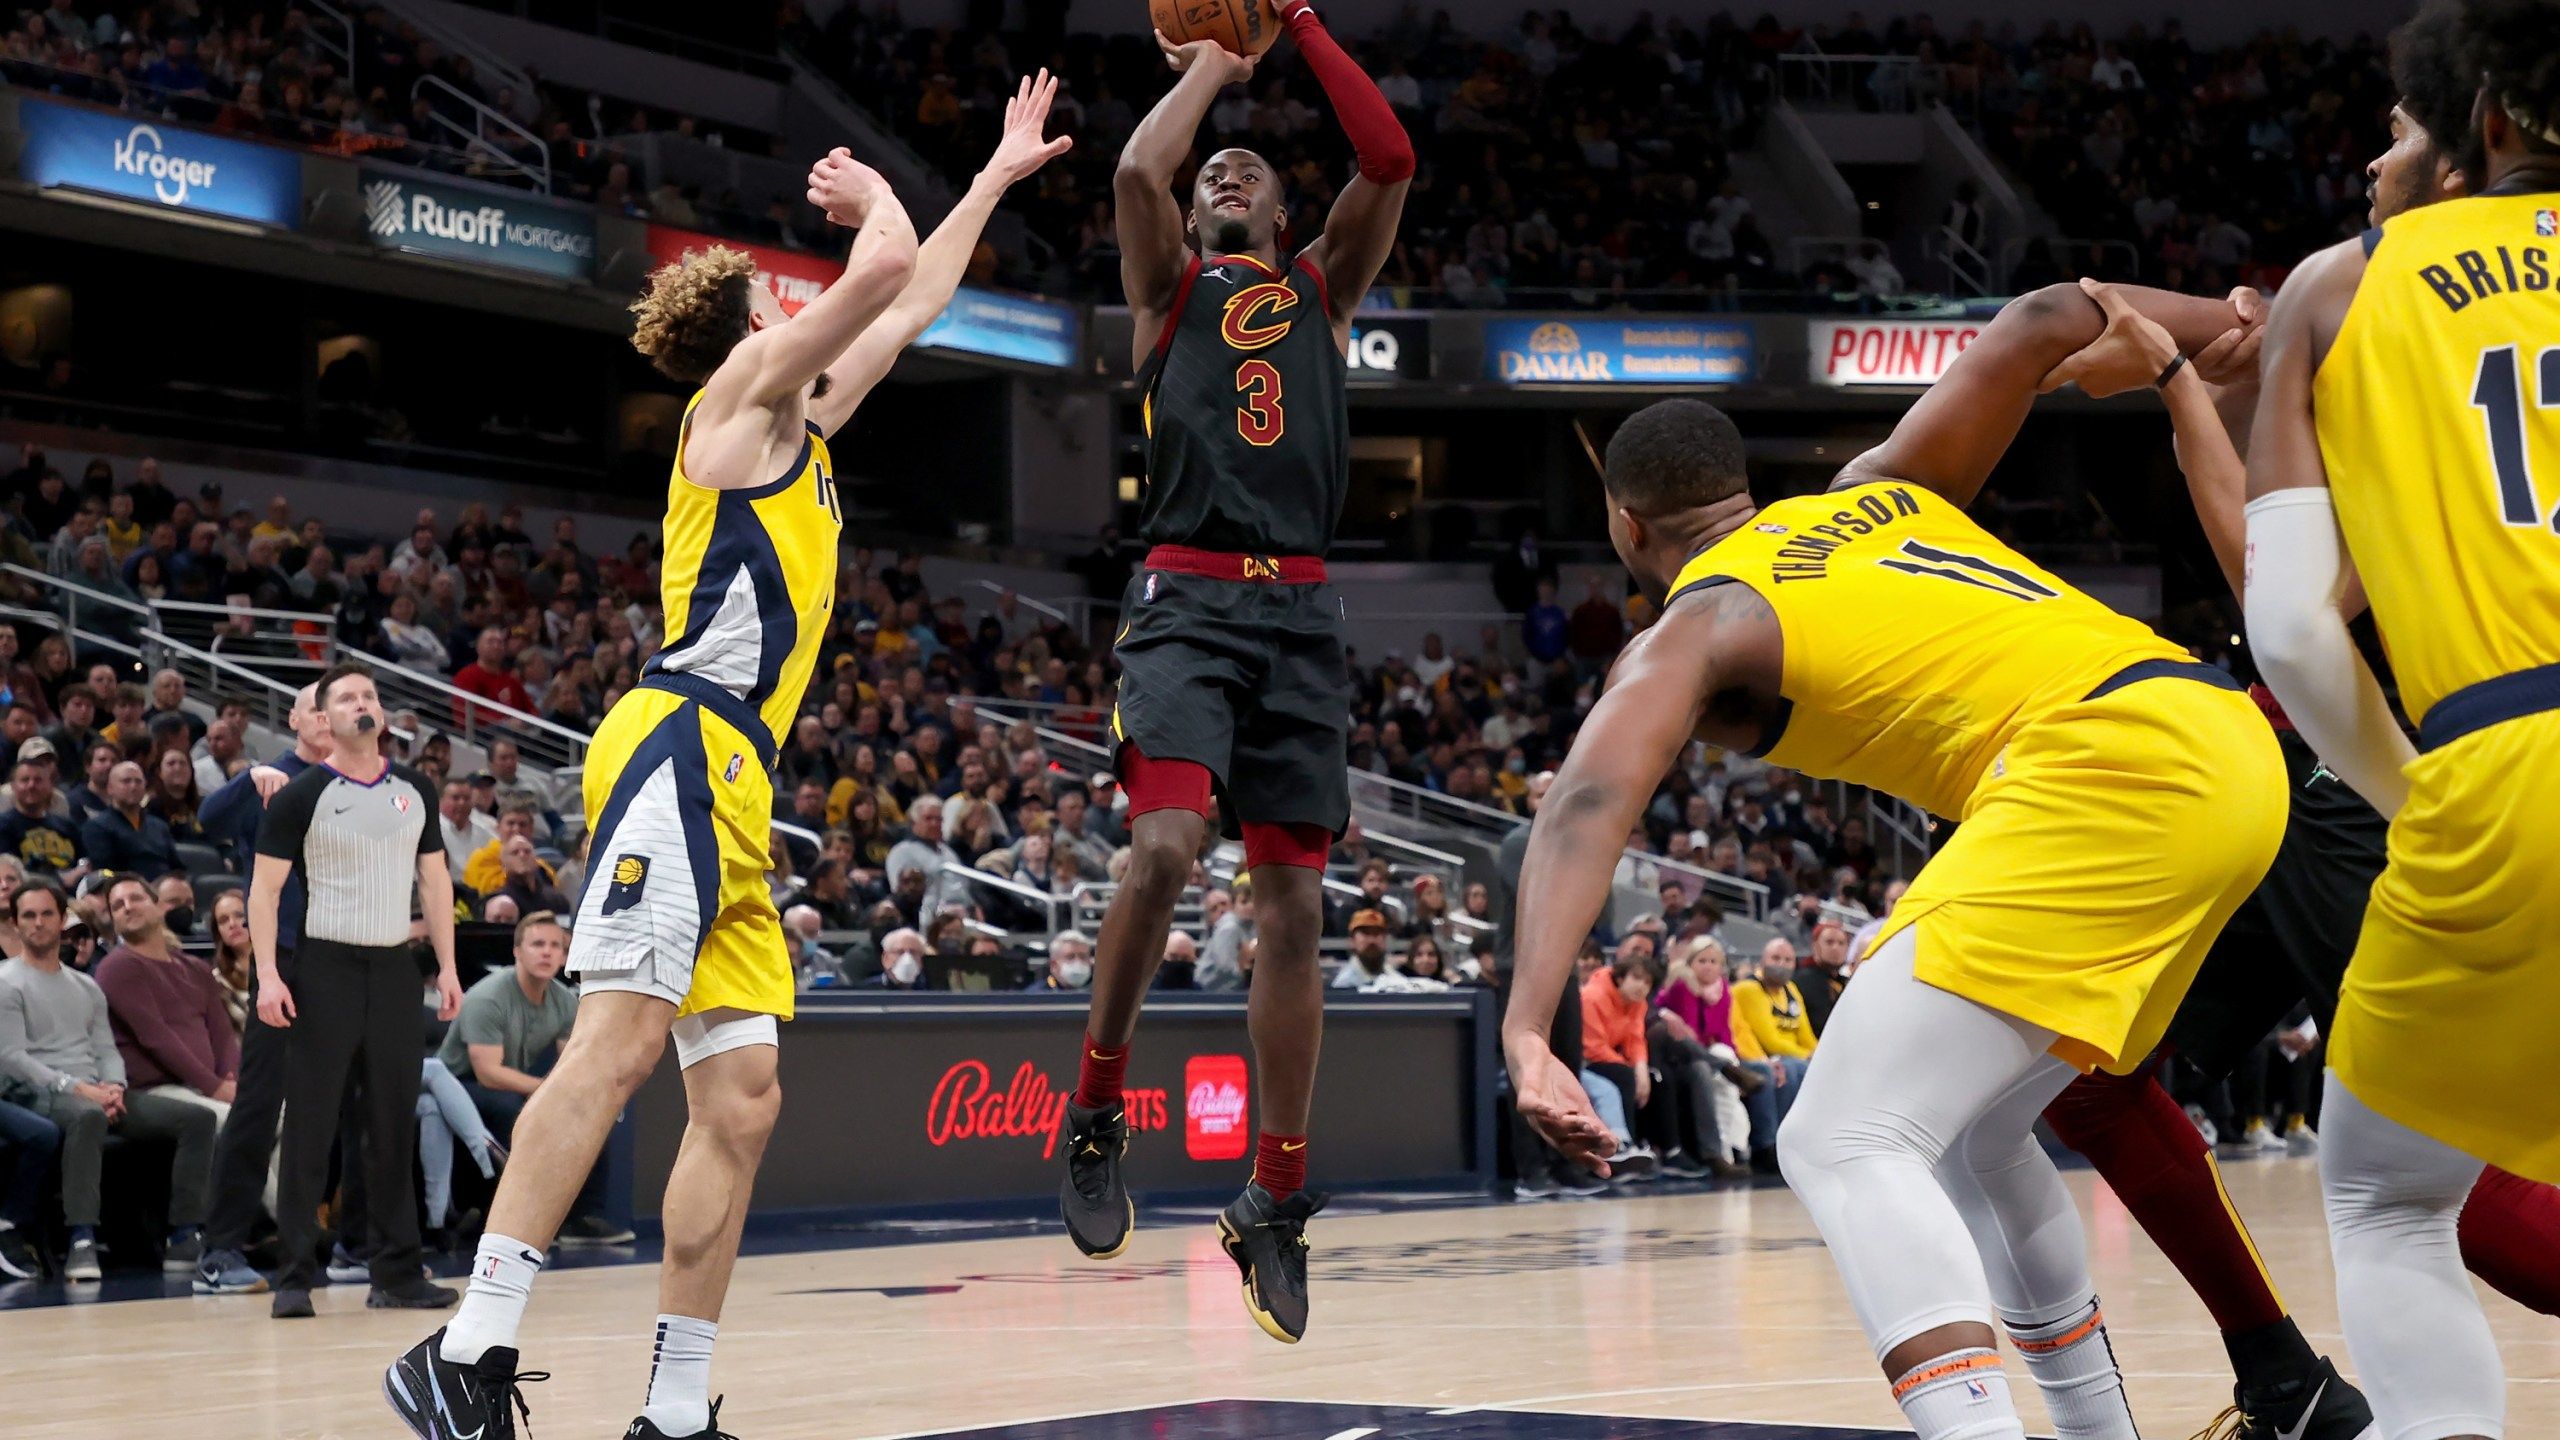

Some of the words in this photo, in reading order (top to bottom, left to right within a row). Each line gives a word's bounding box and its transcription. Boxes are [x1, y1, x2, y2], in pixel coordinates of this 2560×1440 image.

[114, 124, 216, 206] Kroger
[412, 194, 505, 248] Ruoff
[506, 222, 593, 258] MORTGAGE
[2418, 245, 2560, 313] BRIS
[1221, 283, 1298, 350] C
[1499, 351, 1613, 380] DAMAR
[1236, 360, 1284, 446] 3
[1772, 487, 1920, 584] THOMPSON
[1877, 536, 2063, 602] 11
[926, 1058, 1068, 1160] Bally
[1121, 1087, 1169, 1132] RTS
